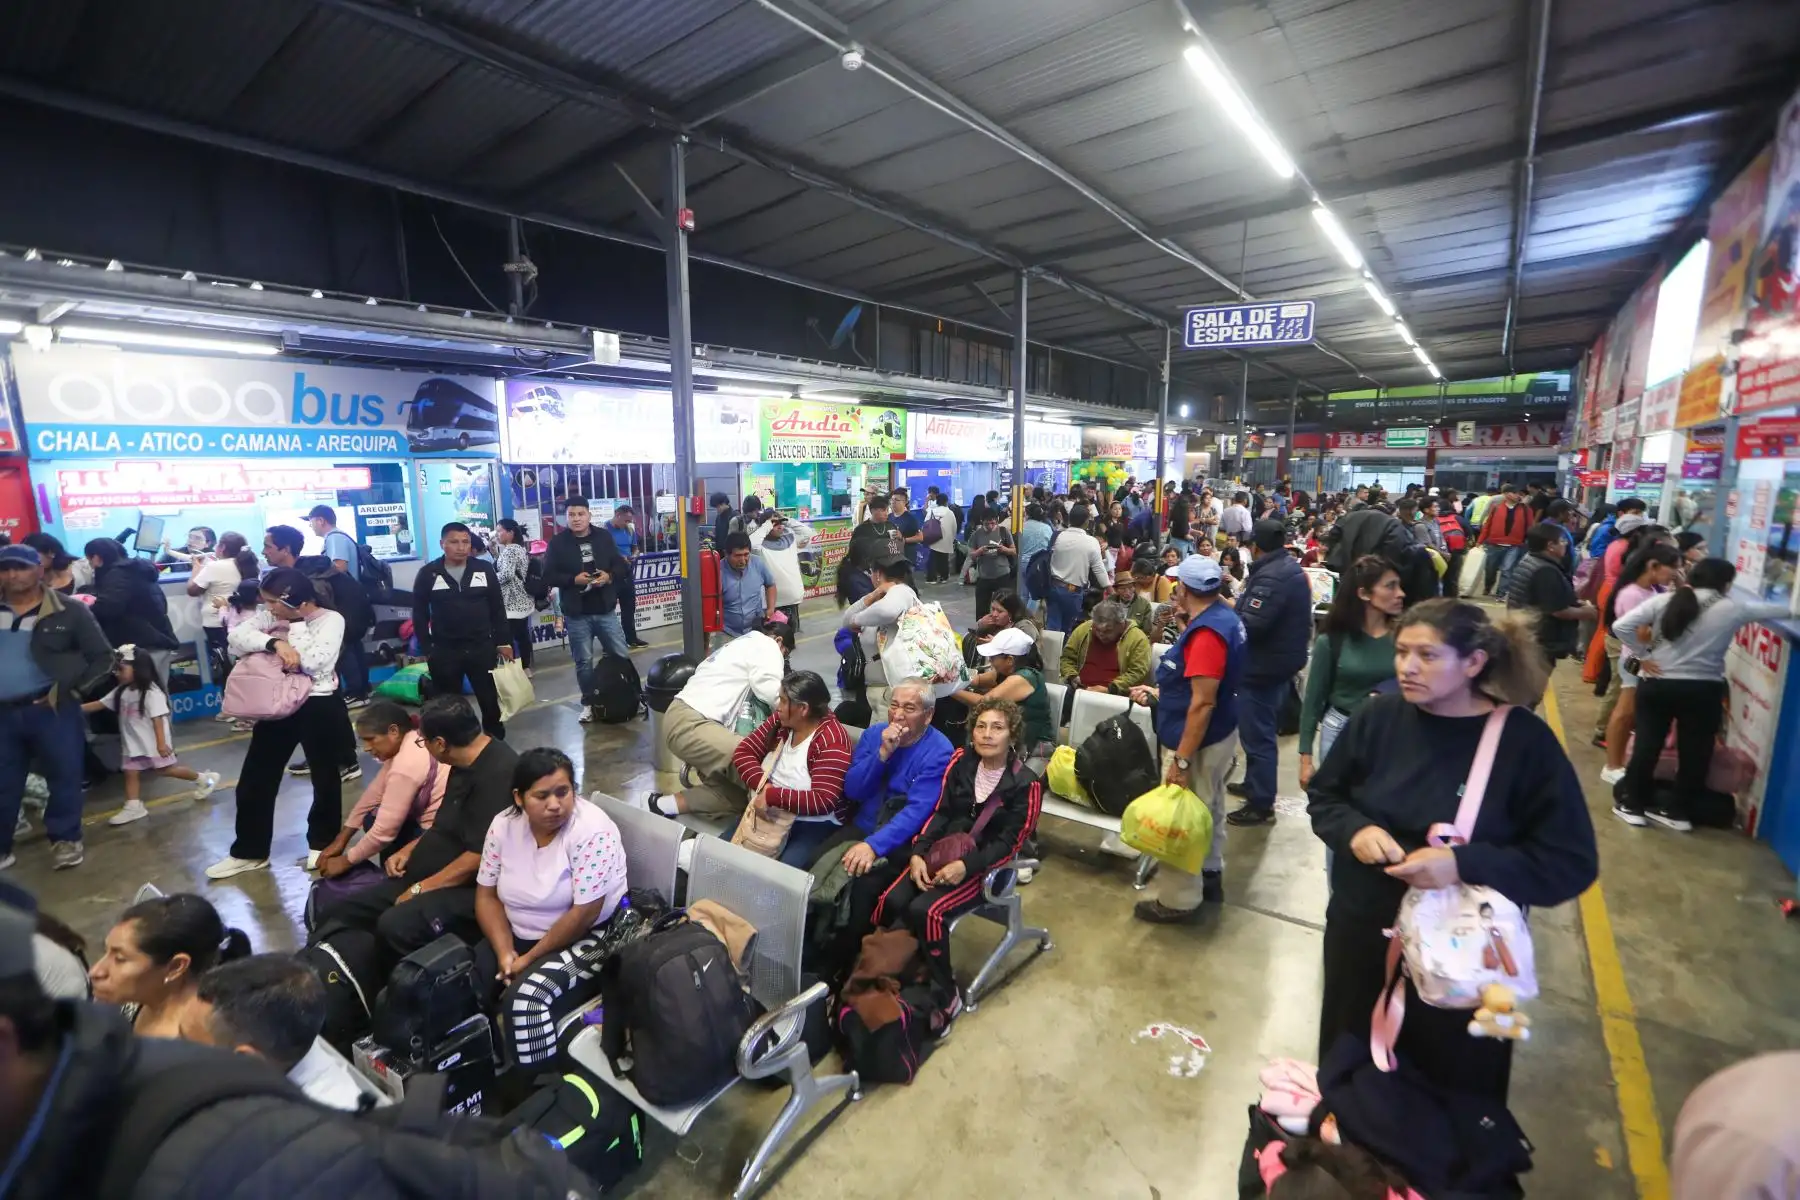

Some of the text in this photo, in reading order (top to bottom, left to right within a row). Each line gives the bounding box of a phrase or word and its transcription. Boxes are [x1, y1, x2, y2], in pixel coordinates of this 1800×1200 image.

[1192, 310, 1243, 329] SALA
[1249, 307, 1278, 325] DE
[1193, 324, 1273, 343] ESPERA
[771, 410, 853, 432] Andia
[37, 430, 122, 452] CHALA
[139, 432, 203, 452] ATICO
[221, 433, 303, 452] CAMANA
[316, 434, 398, 453] AREQUIPA
[768, 444, 880, 459] AYACUCHO URIPA ANDAHUAYLAS
[359, 505, 405, 514] AREQUIPA
[385, 517, 397, 525] PM
[634, 560, 681, 580] inoz
[1734, 621, 1783, 674] AYRO
